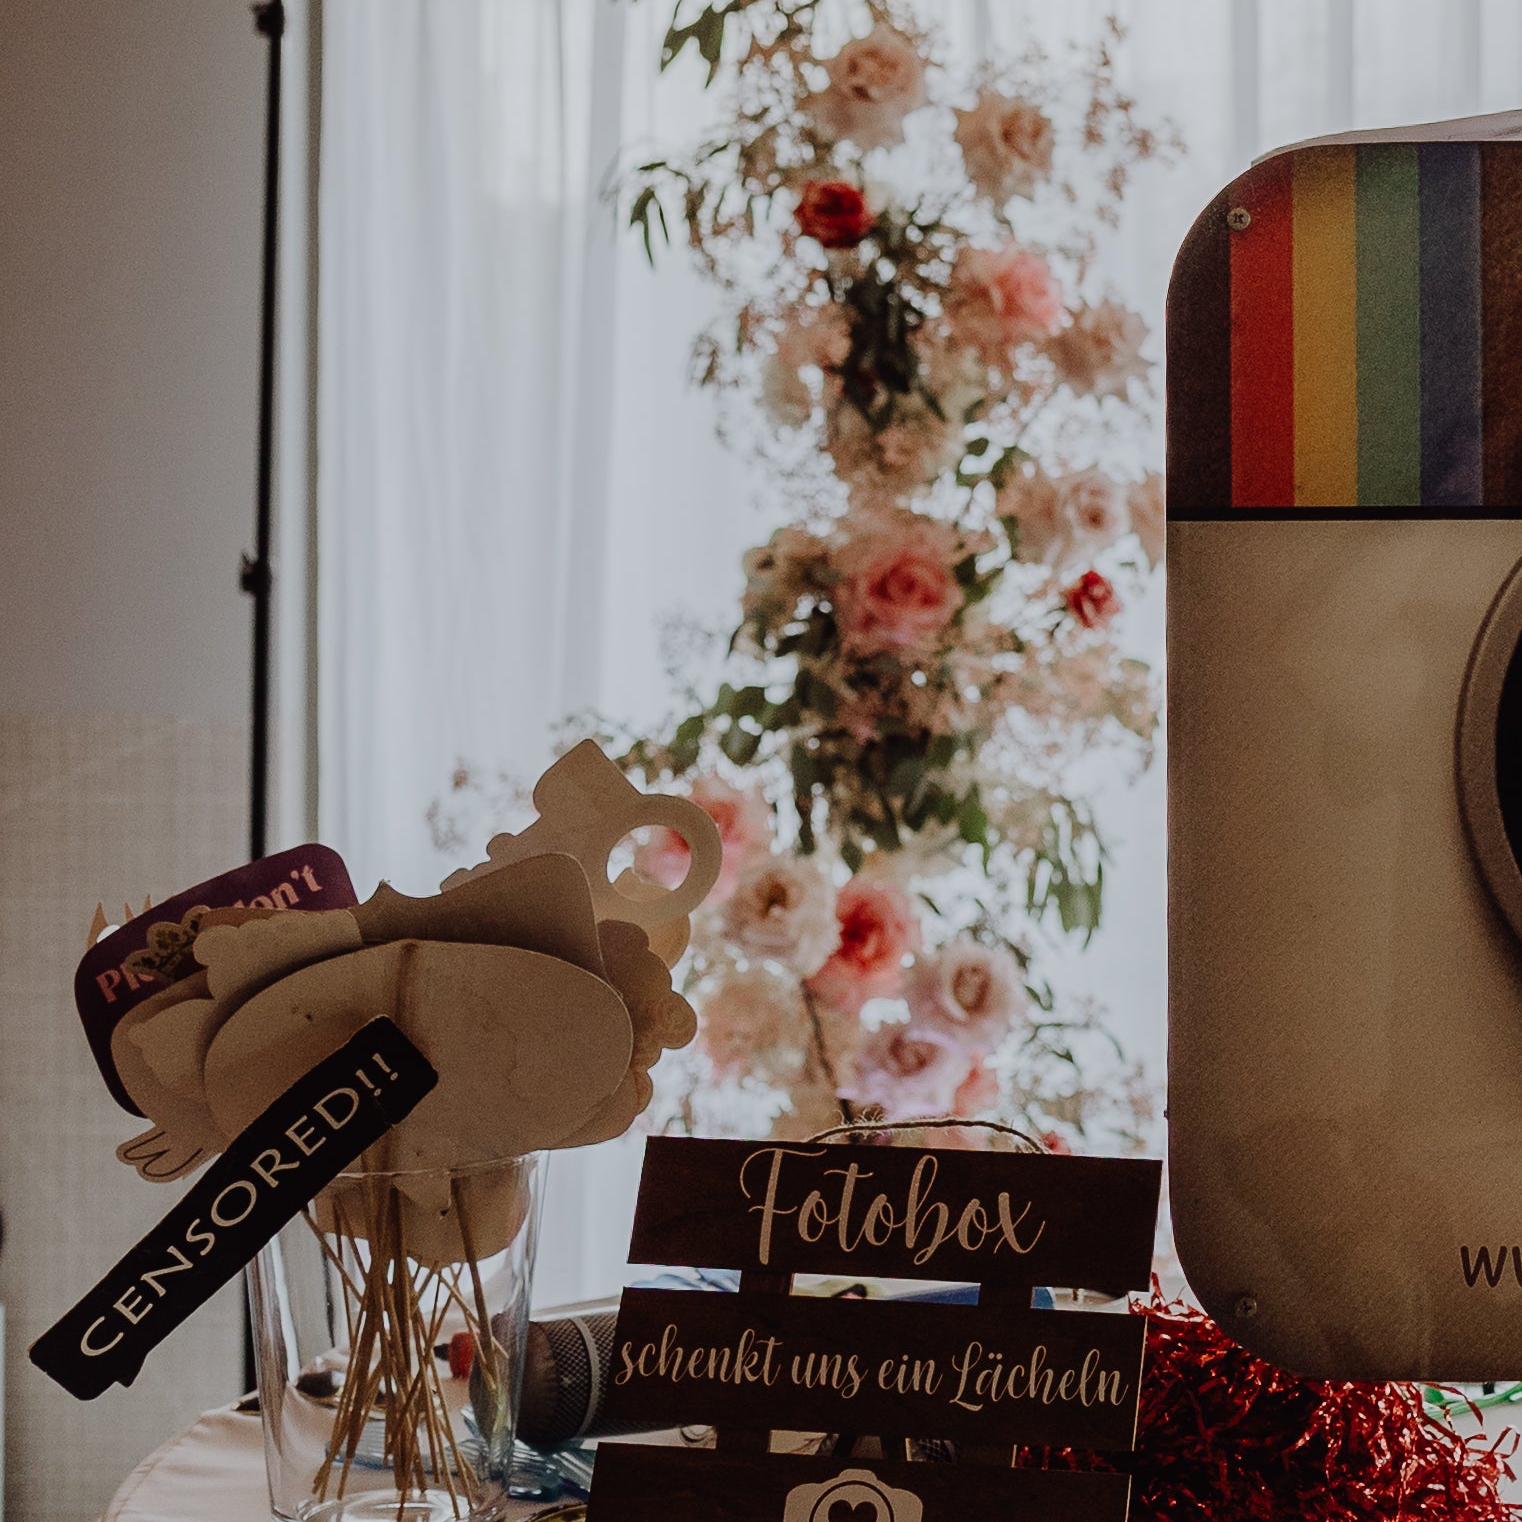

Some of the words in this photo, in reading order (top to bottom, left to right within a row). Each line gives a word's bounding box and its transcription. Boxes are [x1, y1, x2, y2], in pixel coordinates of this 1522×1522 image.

[79, 1052, 399, 1358] CENSORED!!
[739, 1148, 1046, 1266] Fotobox
[615, 1324, 782, 1387] schenkt
[791, 1351, 867, 1399] uns
[878, 1353, 943, 1395] ein
[949, 1340, 1130, 1412] Lächeln
